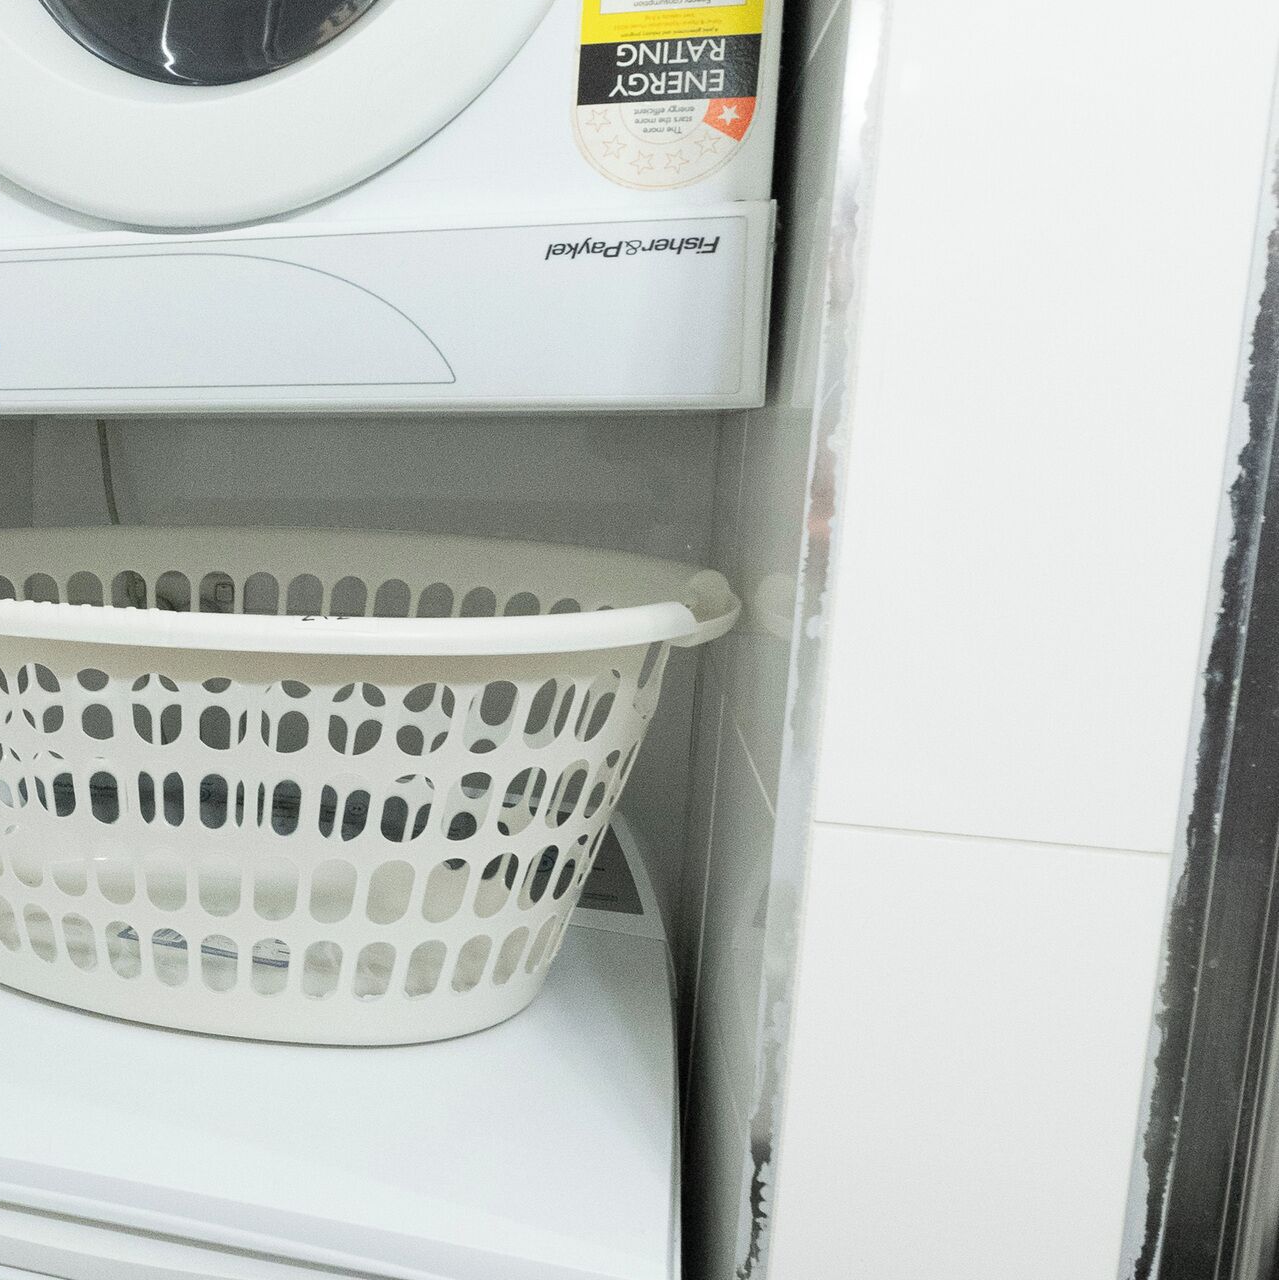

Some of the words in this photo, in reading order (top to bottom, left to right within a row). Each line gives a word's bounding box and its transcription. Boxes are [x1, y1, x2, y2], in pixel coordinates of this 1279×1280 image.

[616, 38, 726, 66] RATING
[609, 69, 724, 97] ENERGY
[634, 108, 664, 116] efficient
[667, 105, 695, 114] energy
[545, 236, 720, 260] Fisher&Paykel
